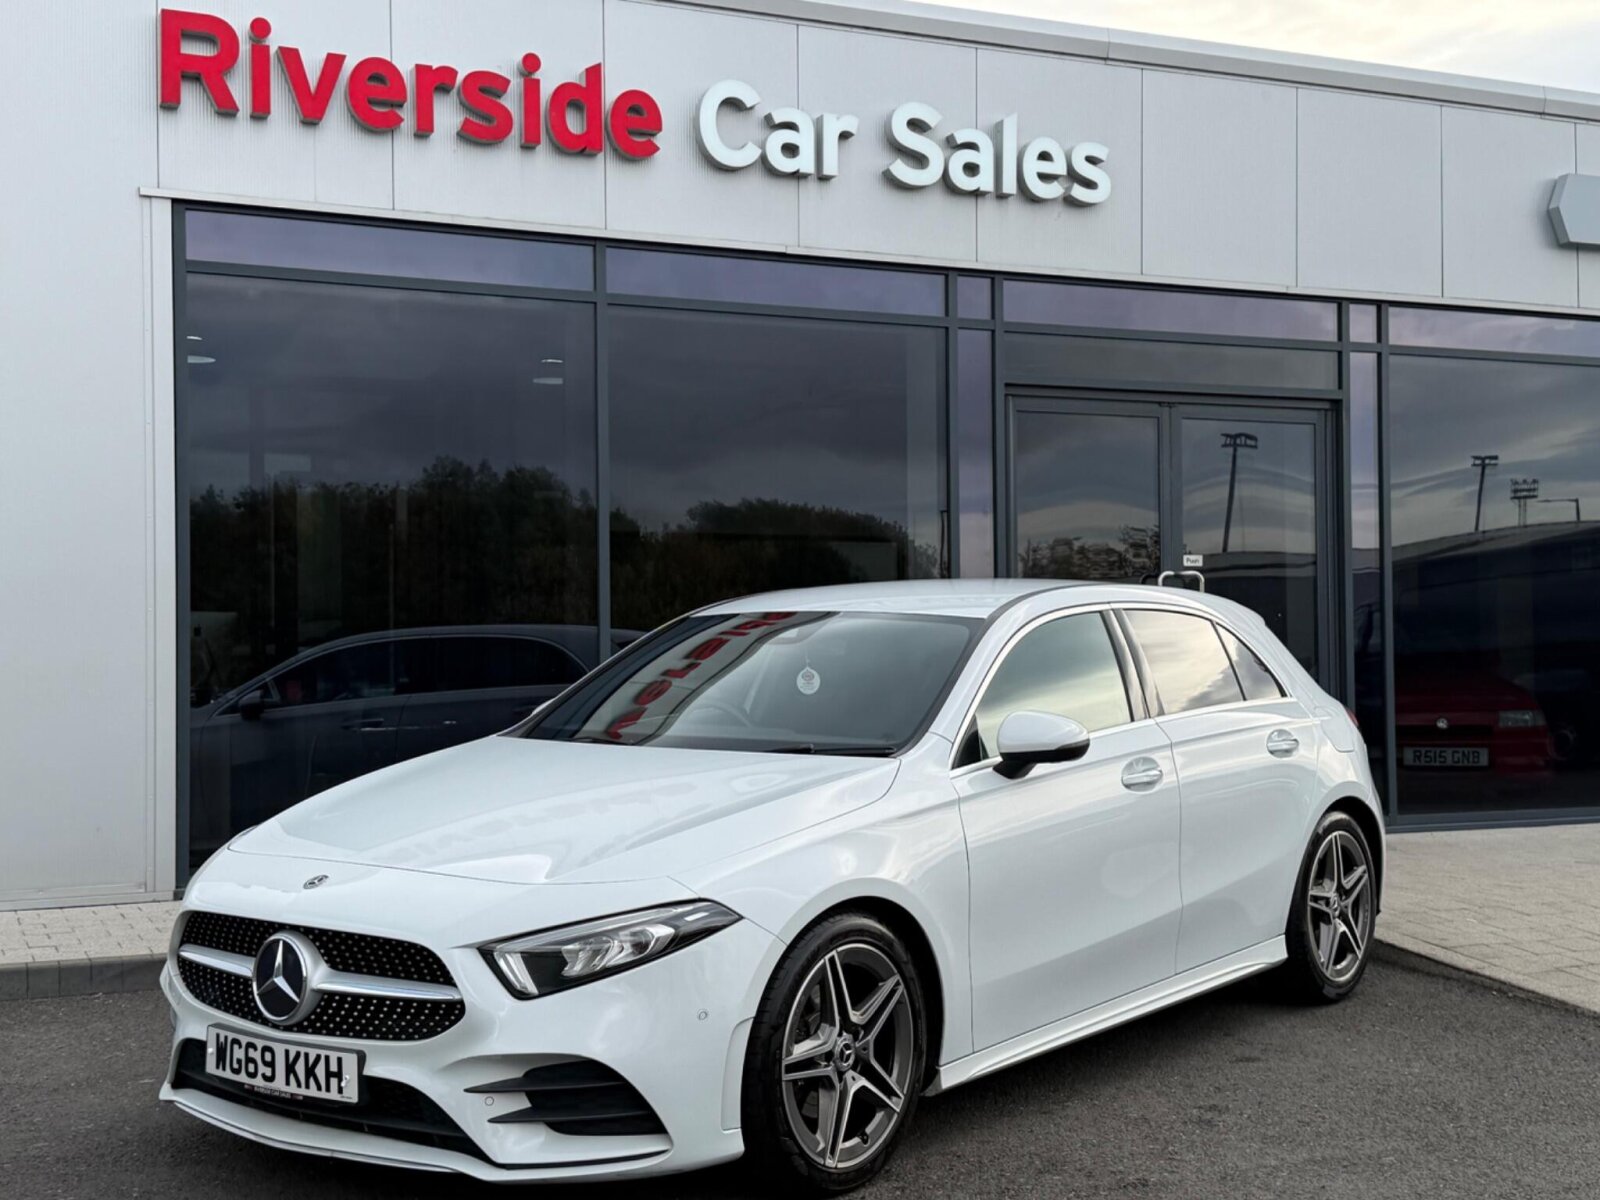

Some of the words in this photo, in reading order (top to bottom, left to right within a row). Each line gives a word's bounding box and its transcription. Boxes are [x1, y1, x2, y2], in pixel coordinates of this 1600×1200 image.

[159, 8, 663, 161] Riverside
[699, 79, 859, 181] Car
[882, 102, 1112, 206] Sales
[1451, 750, 1480, 764] GNB
[215, 1033, 276, 1083] WG69
[284, 1048, 344, 1095] KKH
